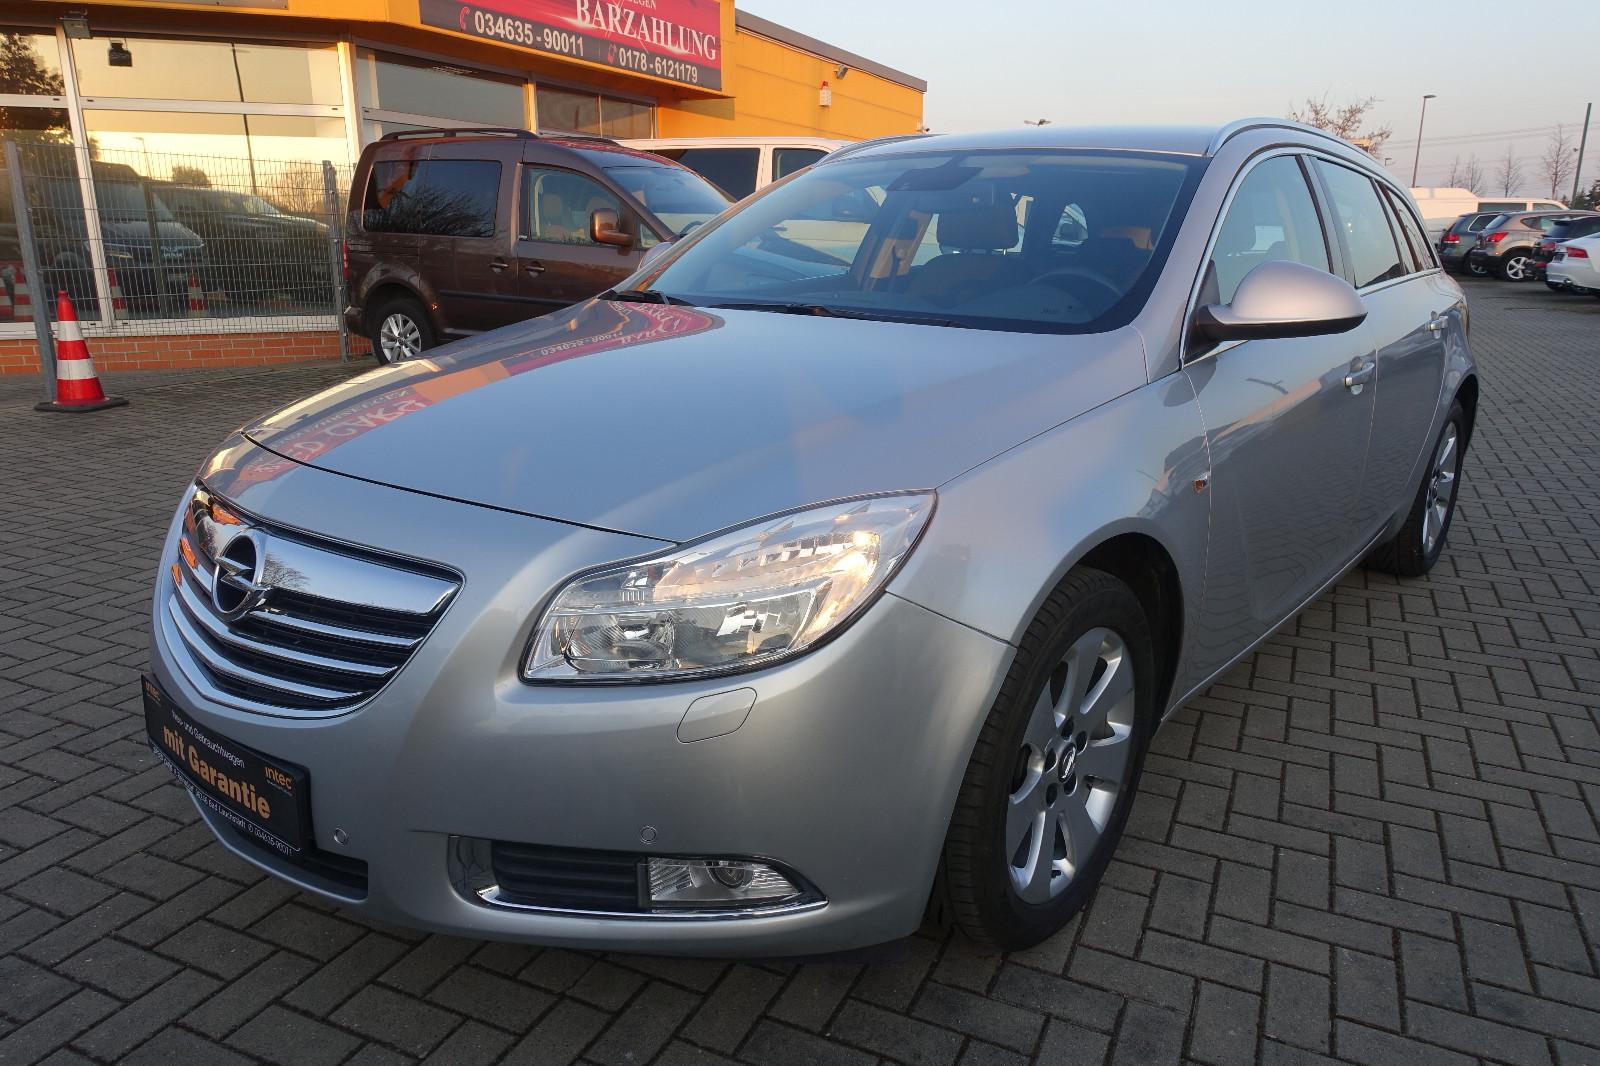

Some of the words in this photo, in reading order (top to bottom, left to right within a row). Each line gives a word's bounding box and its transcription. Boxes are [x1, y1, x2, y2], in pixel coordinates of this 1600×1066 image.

[576, 0, 717, 60] BARZAHLUNG
[163, 724, 186, 761] mit
[188, 745, 271, 819] Garantie
